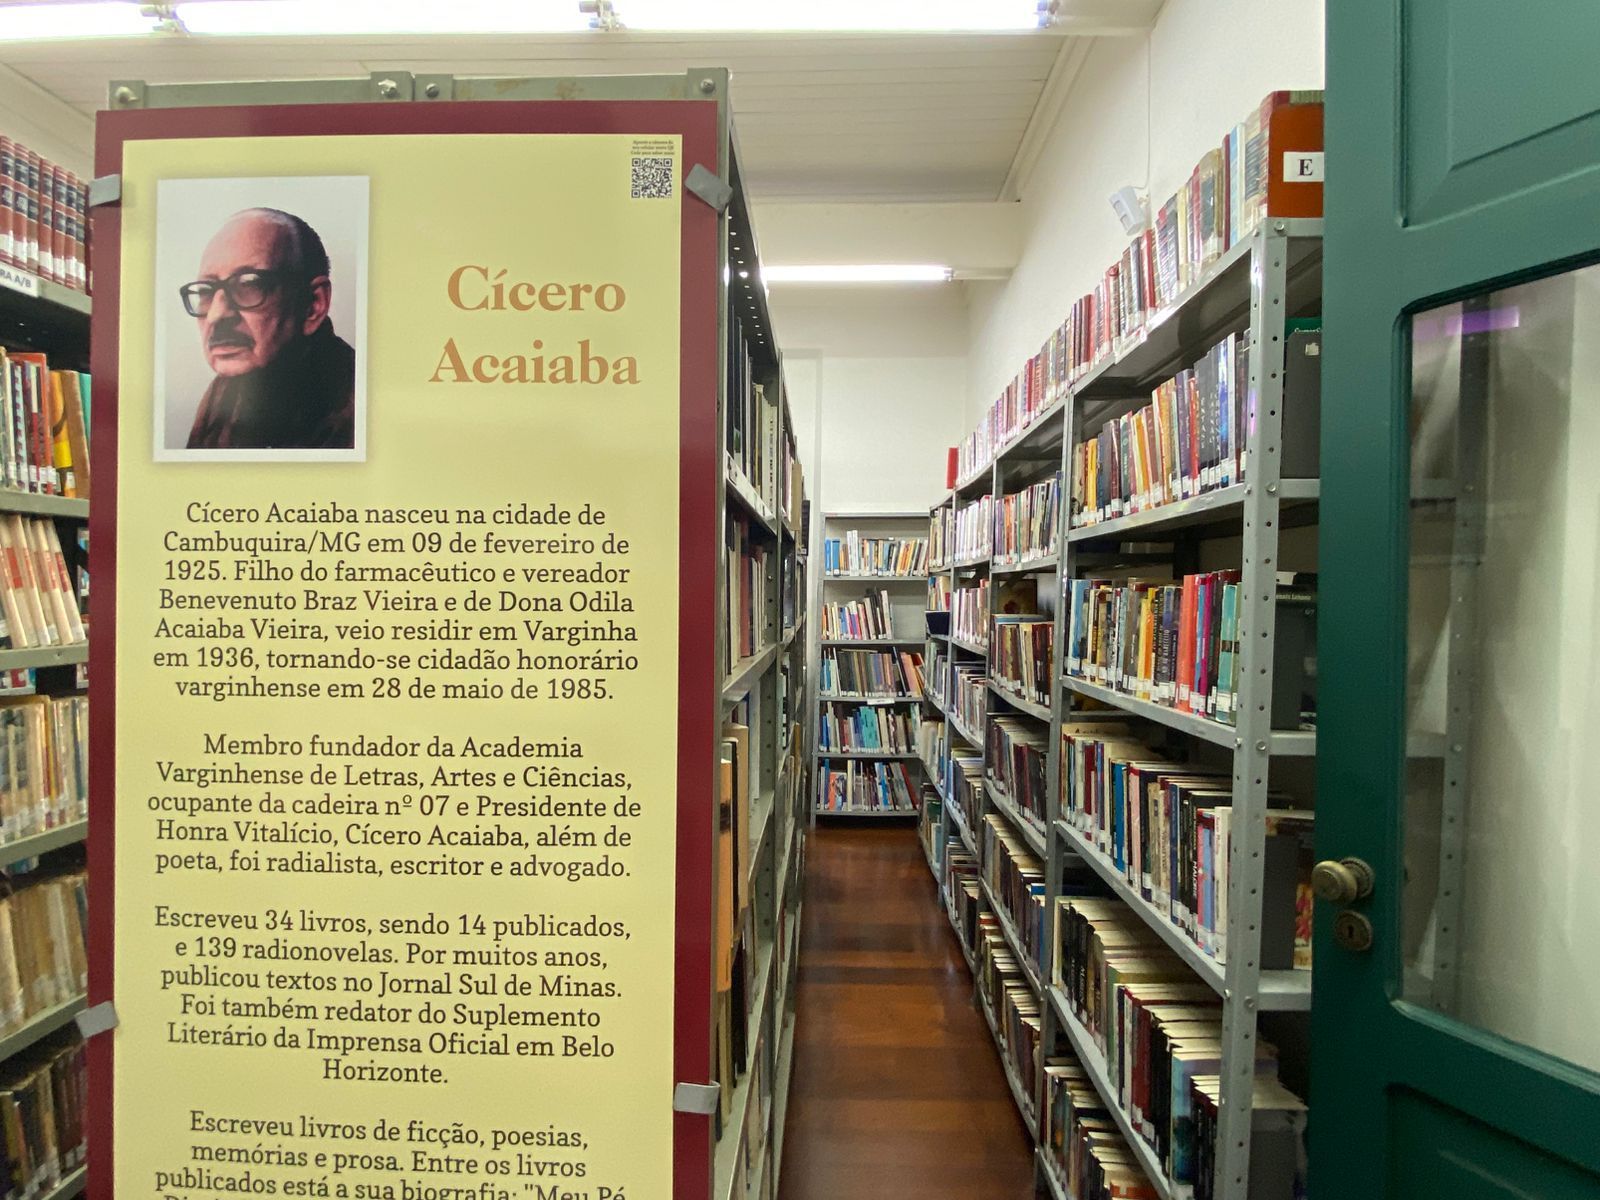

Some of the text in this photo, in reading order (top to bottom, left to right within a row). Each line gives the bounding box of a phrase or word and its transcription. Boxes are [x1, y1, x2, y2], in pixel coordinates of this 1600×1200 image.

[1297, 158, 1313, 176] E
[447, 265, 626, 312] Cícero
[428, 337, 642, 385] Acaiaba
[187, 501, 605, 525] Cícero Acaiaba nasceu na cidade de
[164, 530, 629, 557] Cambuquira/MG em 09 de fevereiro de
[165, 559, 630, 583] 1925. Filho do farmacêutico e vereador
[159, 589, 635, 612] Benevenuto Braz Vieira e de Dona Odila
[154, 617, 638, 646] Acaiaba Vieira, veio residir em Varginha
[154, 646, 638, 671] em 1936, tornando-se cidadão honorário
[175, 675, 613, 702] varginhense em 28 de maio de 1985.
[204, 733, 584, 758] Membro fundador da Academia
[156, 761, 632, 791] Varginhense de Letras, Artes e Ciências,
[148, 795, 252, 817] ocupante
[259, 792, 286, 813] da
[292, 793, 380, 815] cadeira
[420, 795, 450, 816] 07
[457, 802, 469, 816] e
[476, 795, 606, 817] Presidente
[614, 795, 641, 817] de
[156, 819, 631, 850] Honra Vitalício, Cícero Acaiaba, além de
[155, 849, 630, 882] poeta, foi radialista, escritor e advogado.
[155, 906, 630, 941] Escreveu 34 livros, sendo 14 publicados,
[175, 936, 607, 970] e 139 radionovelas. Por muitos anos,
[161, 964, 621, 998] publicou textos no Jornal Sul de Minas.
[181, 993, 600, 1031] Foi também redator do Suplemento
[168, 1022, 614, 1057] Literário da Imprensa Oficial em Belo
[323, 1058, 448, 1083] Horizonte.
[190, 1110, 588, 1151] Escreveu livros de ficção, poesias,
[191, 1142, 586, 1177] memórias e prosa. Entre os livros
[154, 1166, 277, 1194] publicados
[283, 1175, 330, 1197] está
[336, 1183, 350, 1198] a
[354, 1183, 396, 1200] sua
